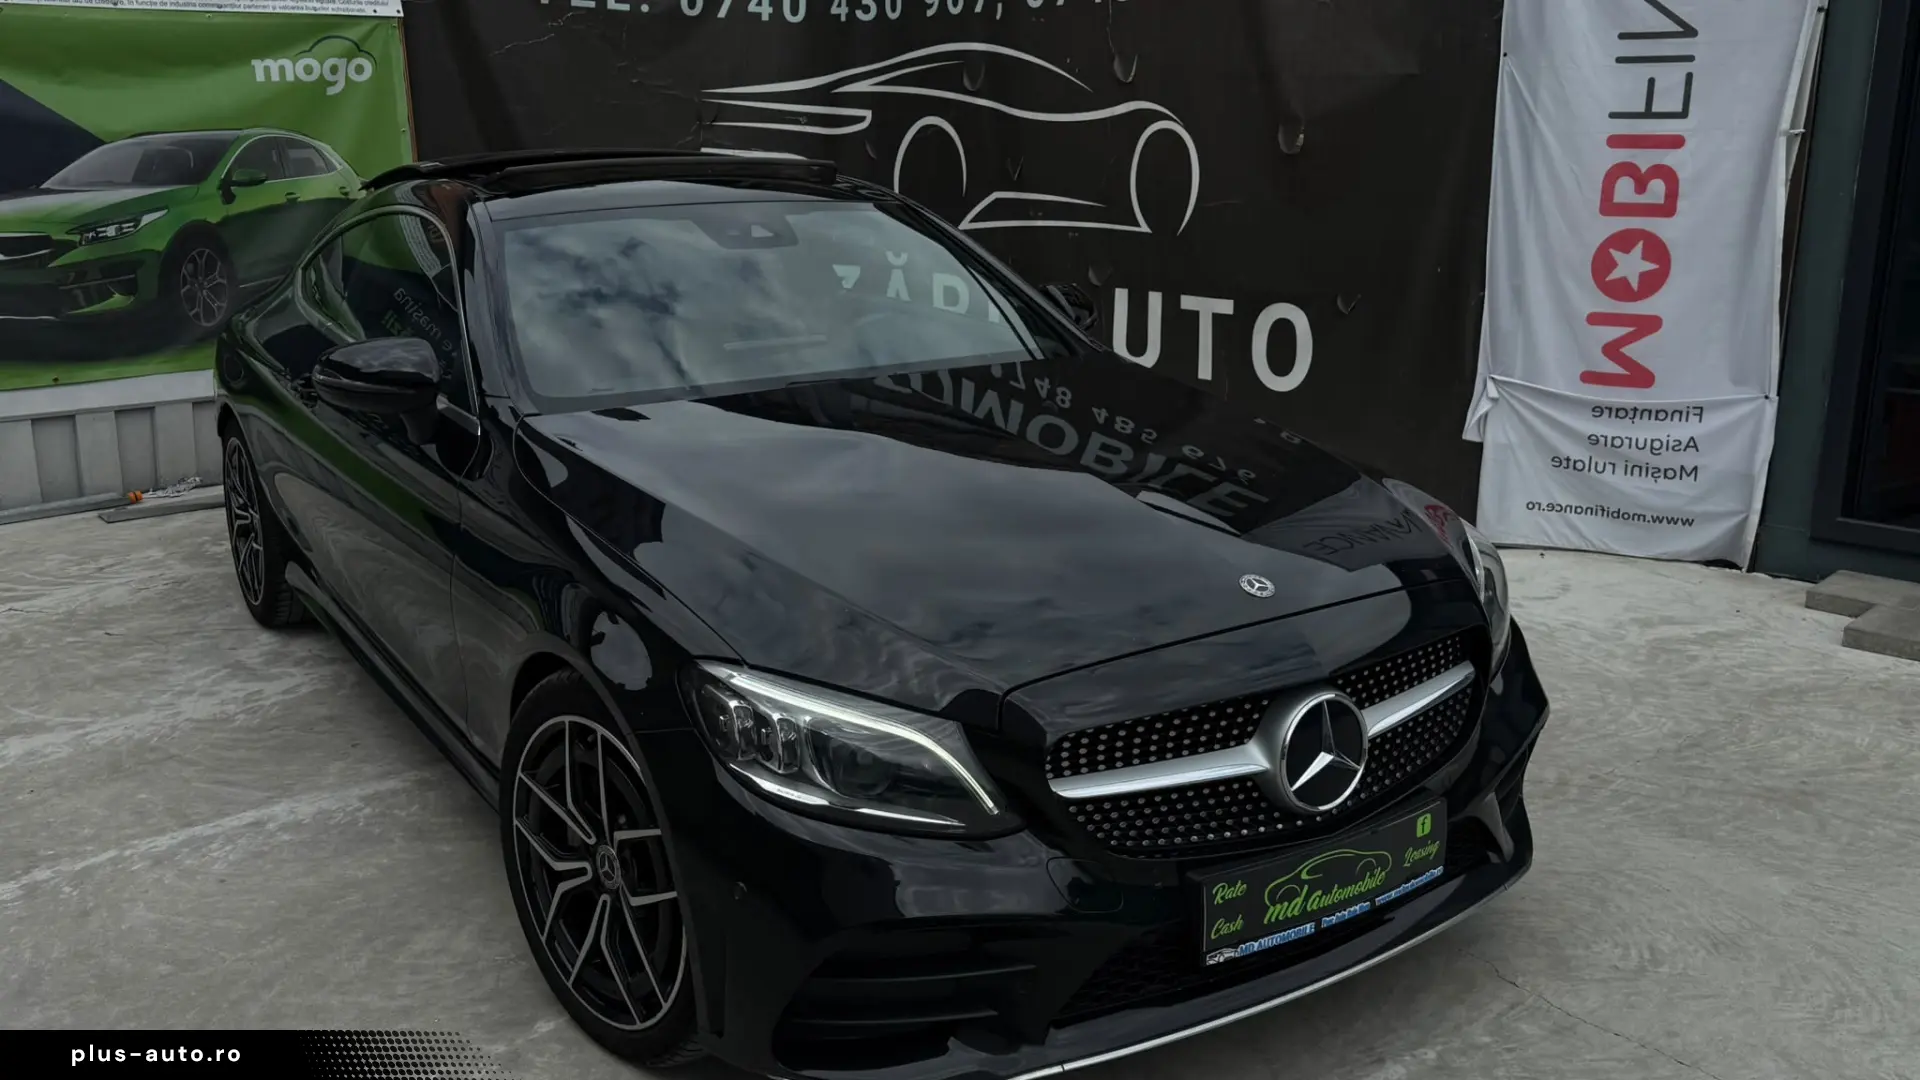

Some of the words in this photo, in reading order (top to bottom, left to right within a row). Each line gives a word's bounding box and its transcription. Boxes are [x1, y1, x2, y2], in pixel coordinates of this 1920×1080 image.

[251, 57, 373, 96] mogo
[1112, 286, 1315, 393] UTO
[1403, 839, 1441, 867] Leasing
[1212, 879, 1247, 905] Rate
[1263, 884, 1309, 924] md
[1211, 913, 1245, 939] Cash
[1256, 922, 1316, 951] AUTOMOBILE
